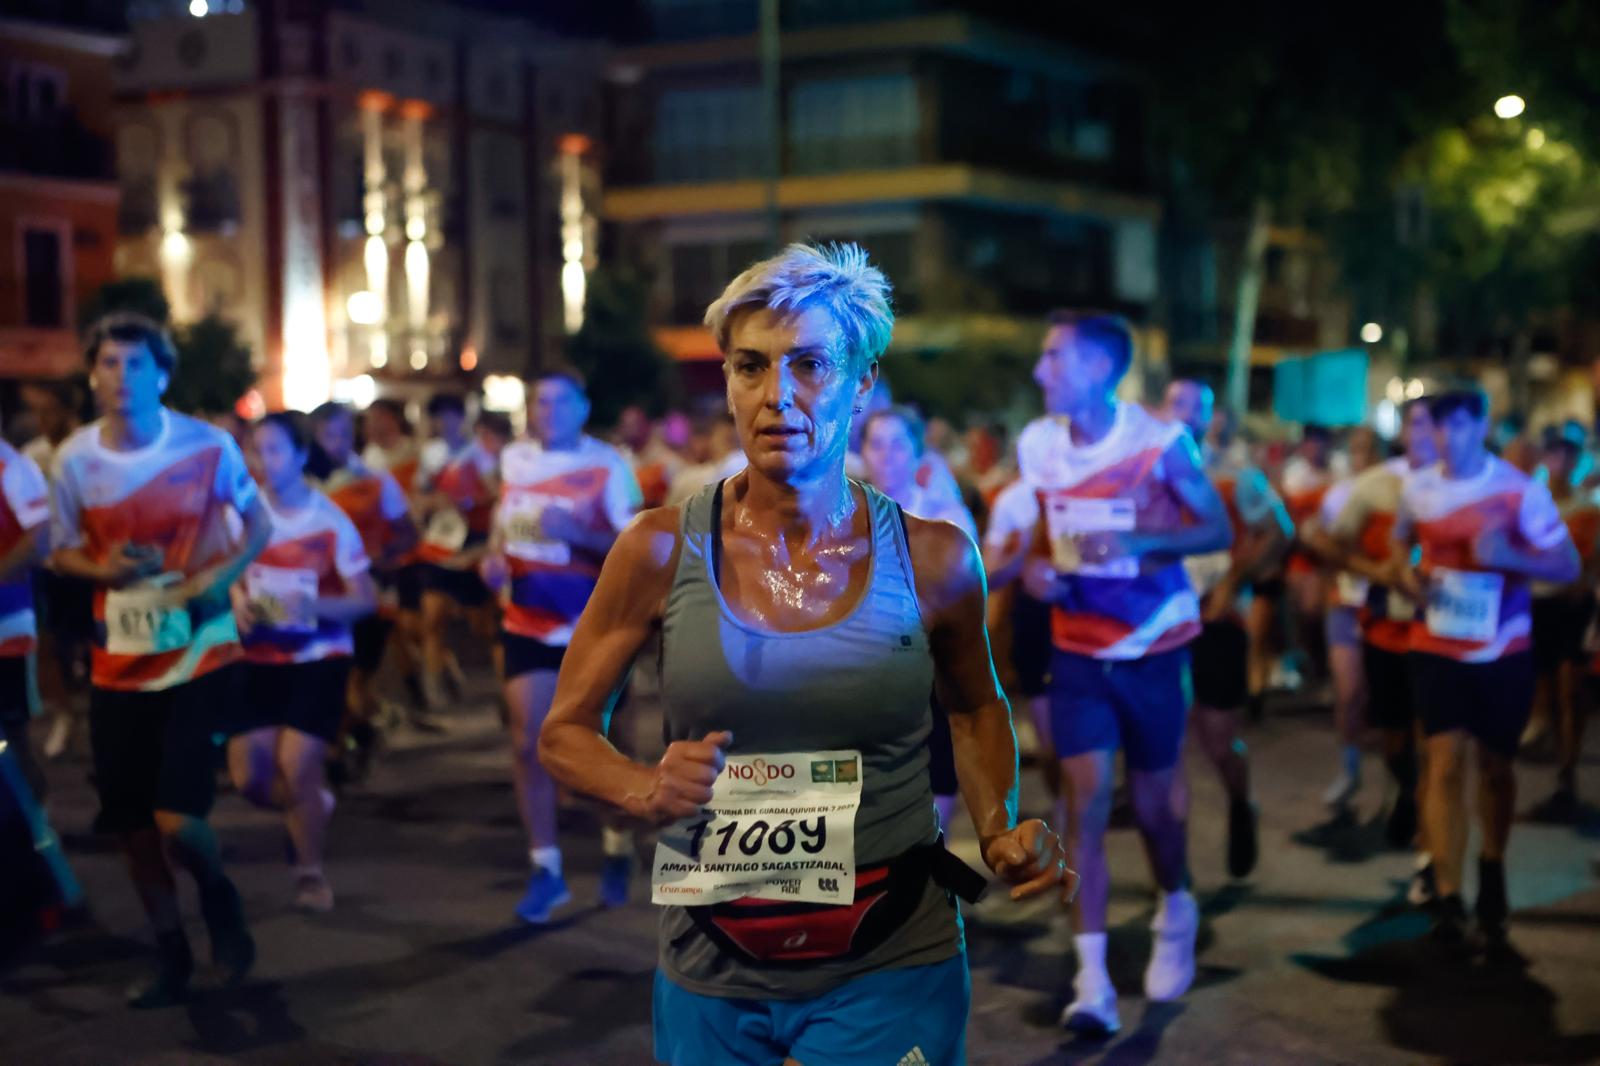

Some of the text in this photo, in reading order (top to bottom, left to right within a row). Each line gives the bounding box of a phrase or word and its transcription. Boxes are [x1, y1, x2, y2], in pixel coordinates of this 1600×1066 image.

[760, 805, 816, 816] GUADALQUIVIR
[686, 816, 826, 857] 11069
[660, 861, 845, 872] AMAYA SANTIAGO SAGASTIZABAL
